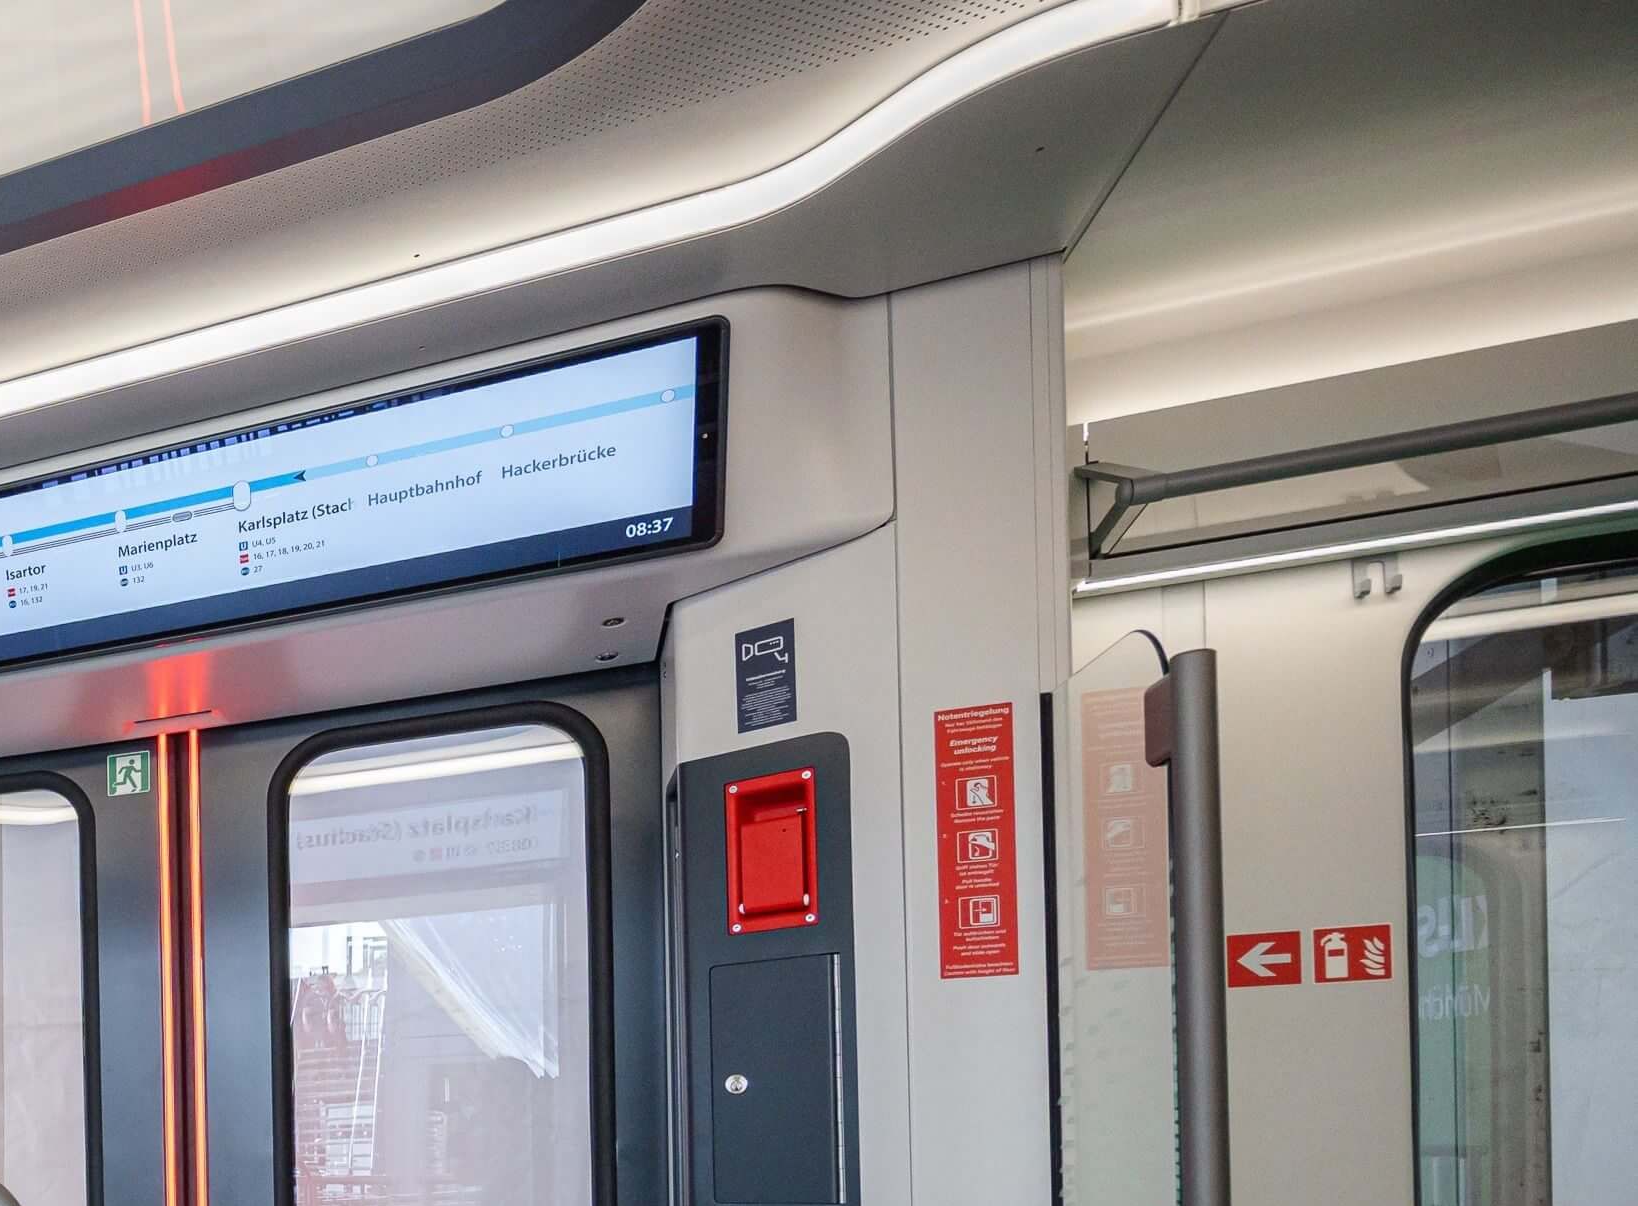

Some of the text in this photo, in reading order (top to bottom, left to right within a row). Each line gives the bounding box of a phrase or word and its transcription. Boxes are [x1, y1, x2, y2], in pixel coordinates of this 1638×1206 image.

[501, 445, 617, 479] Hackerbrücke
[367, 470, 483, 506] Hauptbahnhof
[238, 509, 308, 533] Karlsplatz
[625, 517, 674, 538] 08:37
[118, 533, 198, 558] Marienplatz
[6, 564, 46, 581] Isartor
[253, 565, 263, 573] 27
[938, 707, 1009, 721] Notentriegelung
[949, 735, 999, 747] Emergency
[954, 745, 997, 755] unlocking
